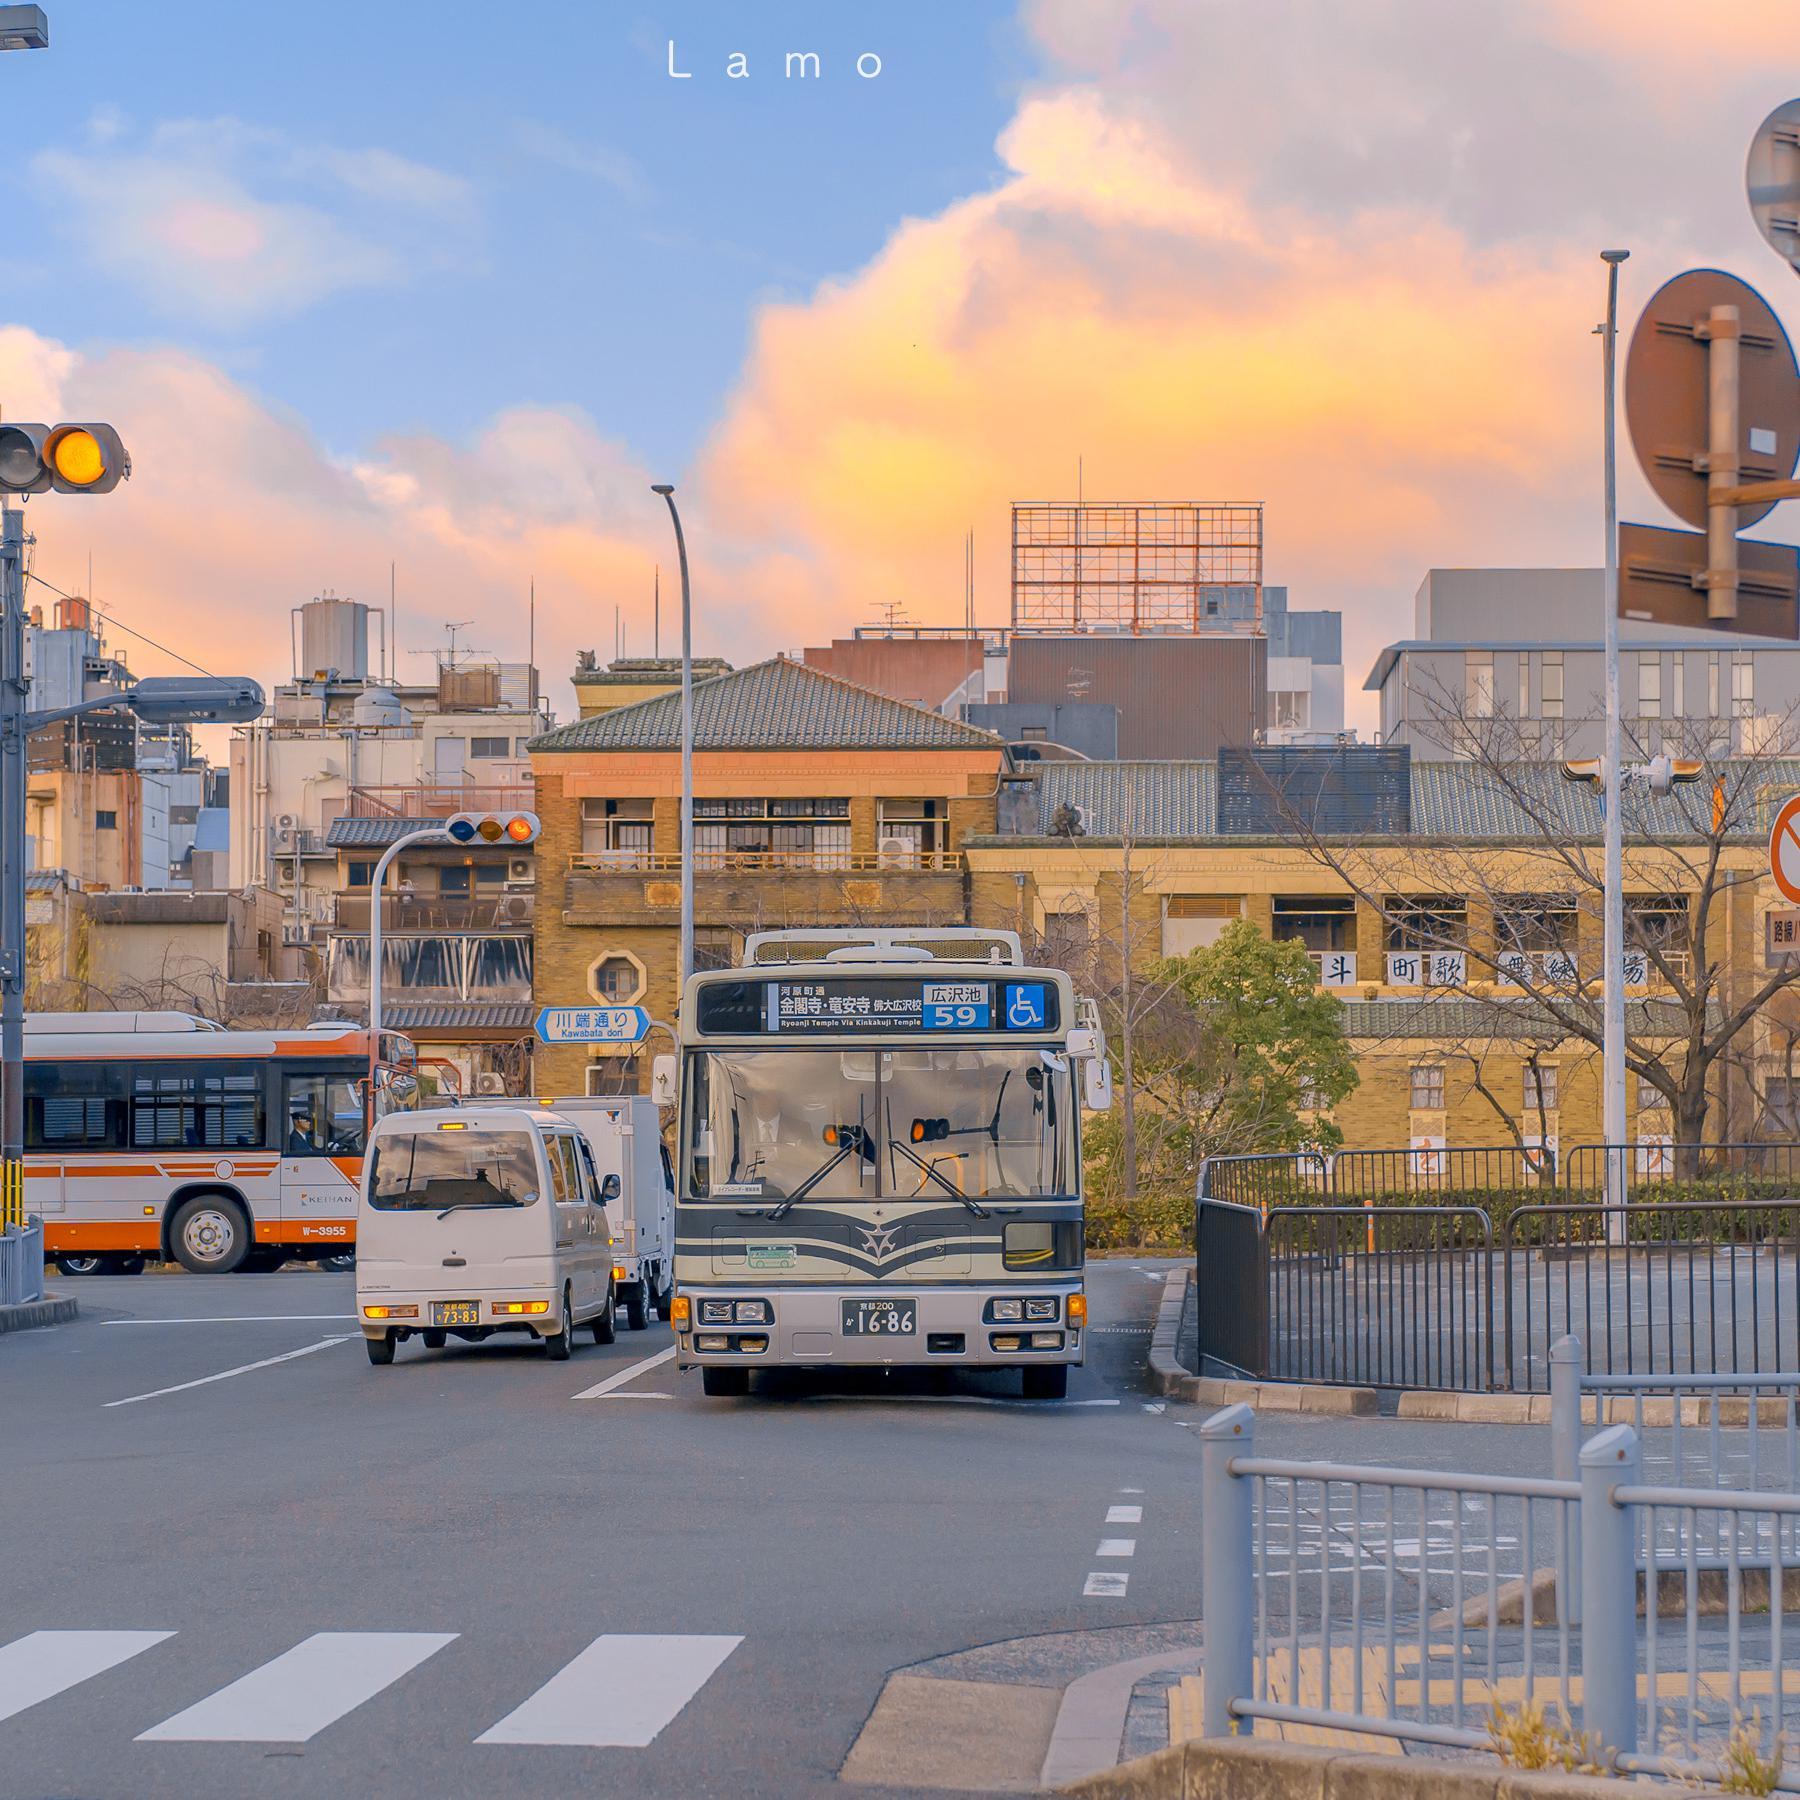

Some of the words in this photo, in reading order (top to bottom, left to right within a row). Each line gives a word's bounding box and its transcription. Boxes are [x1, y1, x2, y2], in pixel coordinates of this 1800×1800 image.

[931, 987, 981, 1003] 広沢池
[556, 1012, 627, 1028] 川端通り
[781, 1020, 810, 1028] Ryoanji
[811, 1020, 839, 1028] Temple
[841, 1019, 853, 1027] Via
[856, 1019, 891, 1027] Kinkakuji
[894, 1019, 922, 1027] Temple
[935, 1006, 977, 1026] 59
[561, 1029, 603, 1038] Kawabata
[607, 1028, 623, 1037] dori
[303, 1226, 347, 1236] W-3955
[858, 1311, 913, 1333] 16-86
